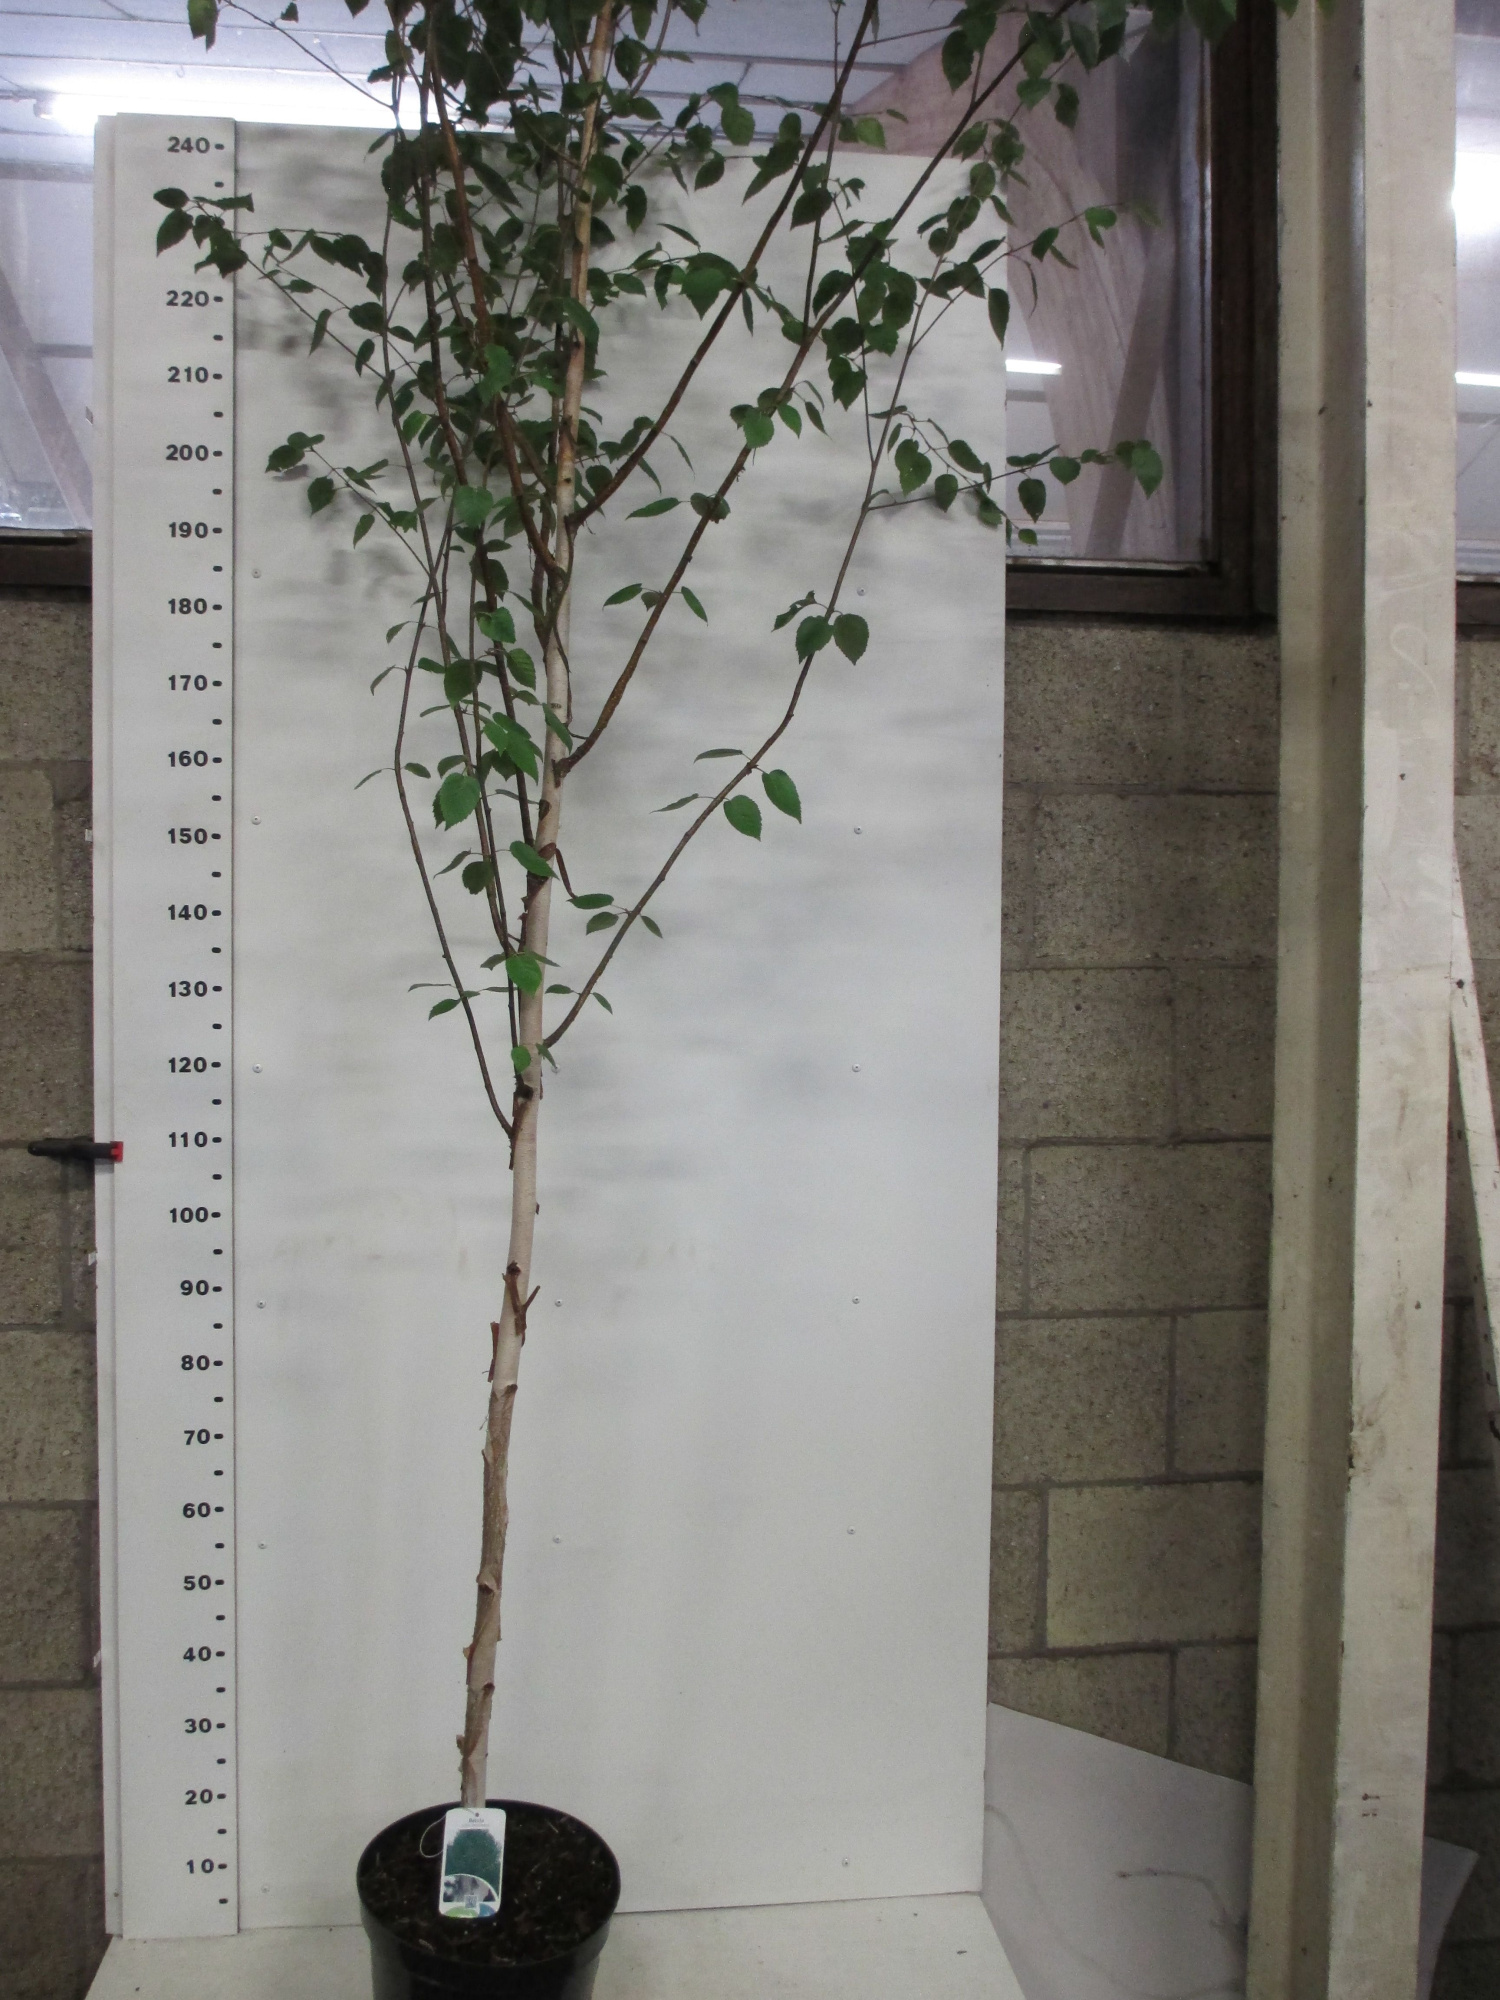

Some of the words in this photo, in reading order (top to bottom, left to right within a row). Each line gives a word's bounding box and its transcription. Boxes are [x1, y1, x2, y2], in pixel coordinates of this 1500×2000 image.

[168, 137, 210, 153] 240
[166, 290, 209, 307] 220
[167, 366, 209, 383] 210
[165, 444, 209, 461] 200
[168, 521, 209, 538] 190
[168, 598, 208, 614] 180
[168, 675, 208, 691] 170
[167, 750, 208, 767] 160
[167, 828, 208, 844] 150
[167, 904, 208, 920] 140
[168, 981, 208, 997] 130
[168, 1057, 208, 1073] 120
[168, 1132, 208, 1148] 110
[169, 1207, 209, 1223] 100
[180, 1280, 210, 1296] 90
[180, 1355, 211, 1370] 80
[183, 1429, 211, 1445] 70
[182, 1502, 211, 1518] 60
[183, 1575, 212, 1591] 50
[182, 1646, 212, 1662] 40
[184, 1718, 212, 1734] 30
[185, 1789, 213, 1805] 20
[186, 1859, 214, 1874] 10
